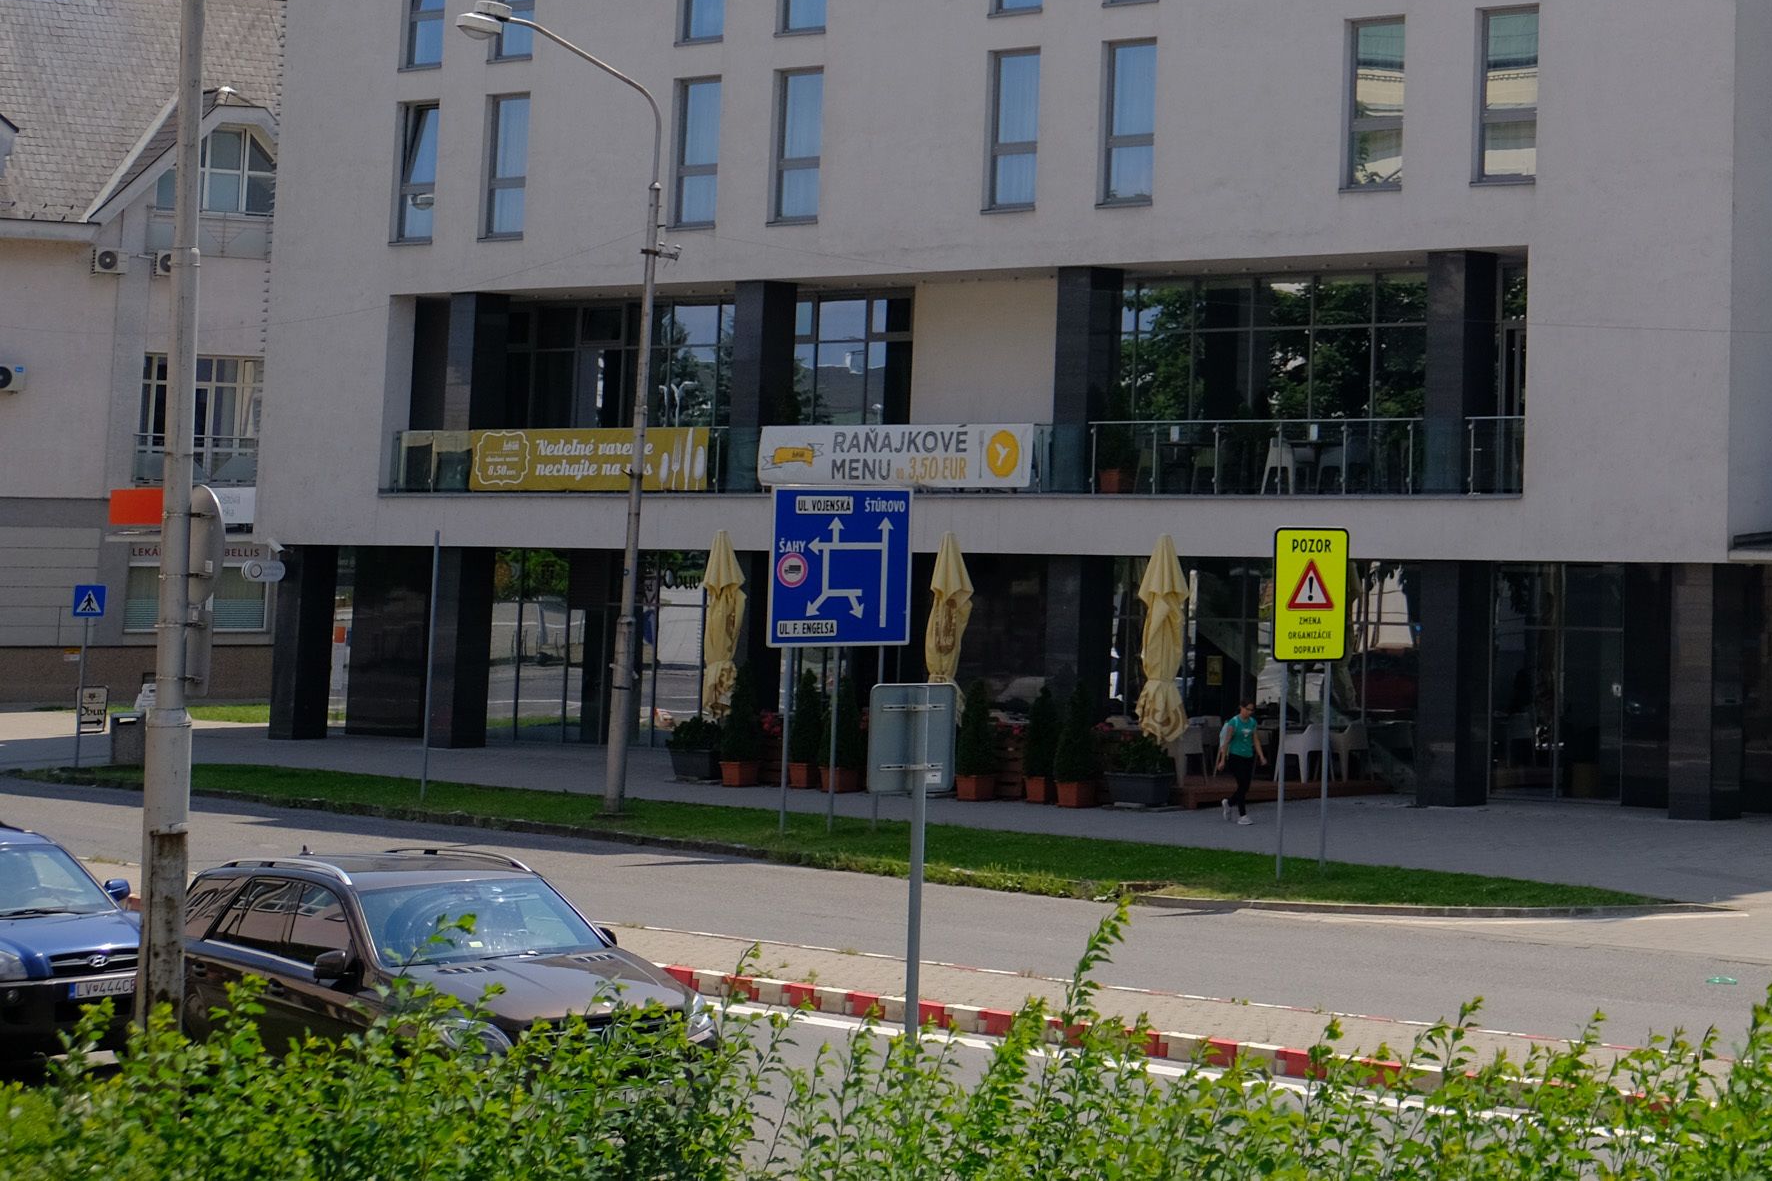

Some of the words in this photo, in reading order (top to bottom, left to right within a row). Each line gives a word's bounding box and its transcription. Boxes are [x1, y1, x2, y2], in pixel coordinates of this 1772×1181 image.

[832, 424, 968, 453] RAŇAJKOVÉ
[535, 459, 598, 481] nechajte
[601, 464, 621, 476] na
[831, 459, 891, 480] MENU
[909, 457, 939, 482] 3,50
[942, 457, 967, 480] EUR
[811, 497, 851, 512] VOJENSKÁ
[864, 497, 906, 513] ŠTÚROVO
[132, 544, 162, 557] LEKÁ
[224, 547, 260, 557] BELLIS
[778, 537, 806, 553] ŠAHY
[1292, 539, 1332, 553] POZOR
[1299, 616, 1322, 625] ZMENA
[802, 621, 835, 635] ENGELSA
[1288, 629, 1332, 640] ORGANIZÁCIE
[1293, 645, 1325, 654] DOPRAVY
[76, 982, 93, 996] LV
